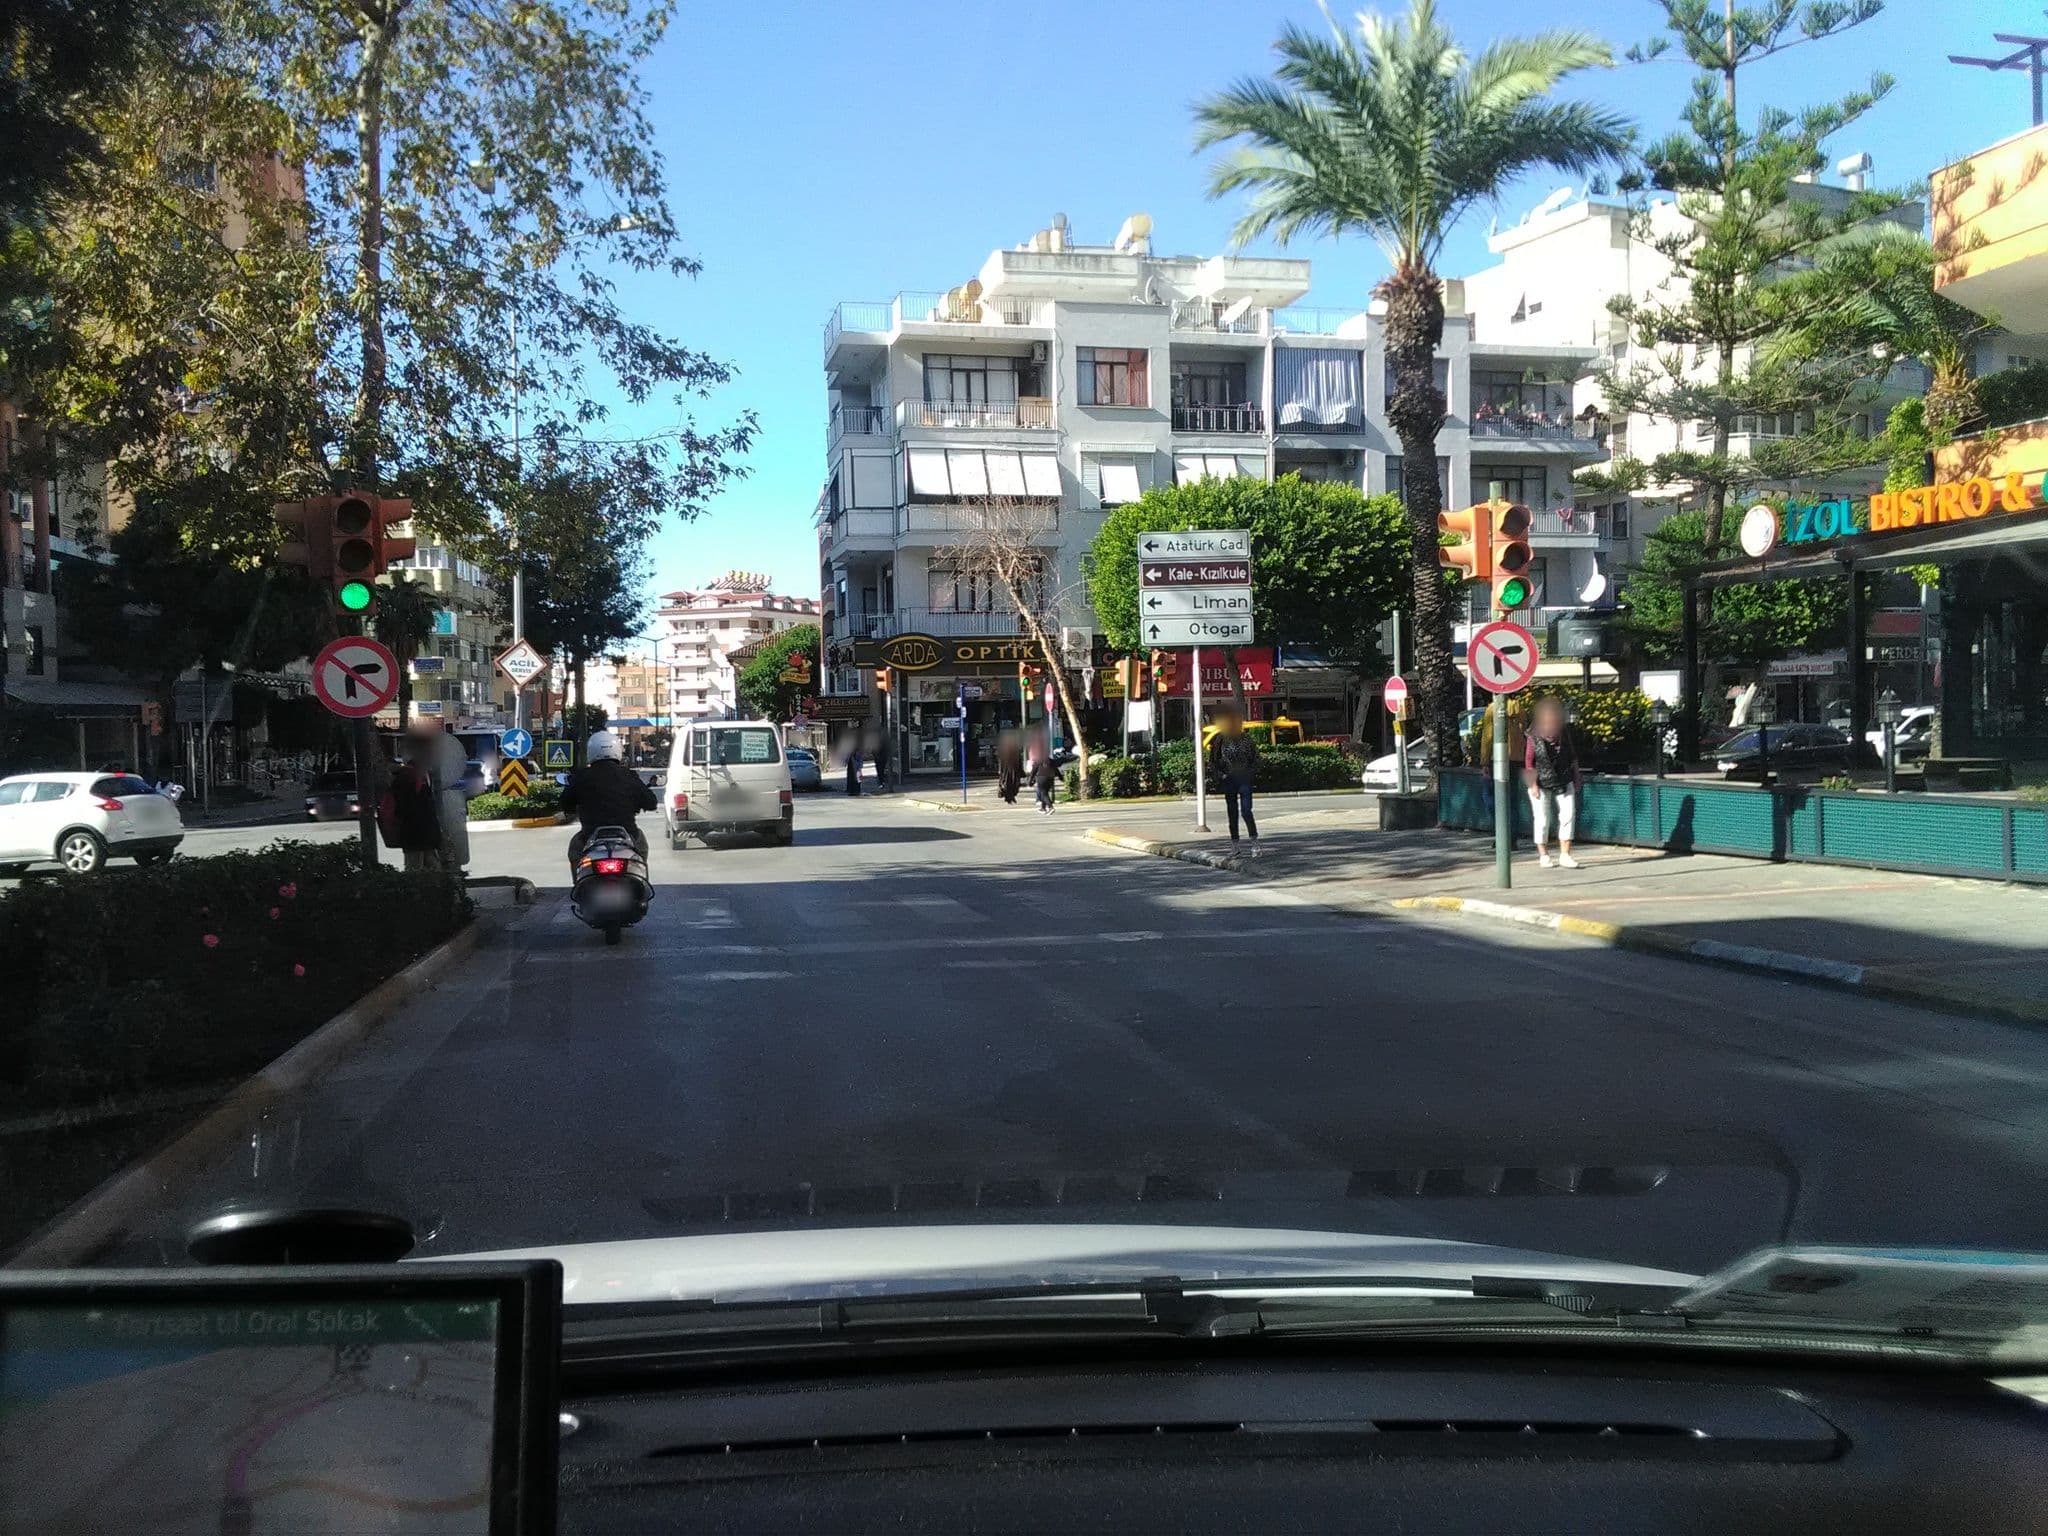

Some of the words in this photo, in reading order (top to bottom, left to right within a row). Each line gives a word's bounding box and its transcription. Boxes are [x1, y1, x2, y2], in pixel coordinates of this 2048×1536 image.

[1870, 477, 1995, 532] BISTRO
[2001, 471, 2034, 512] &
[1166, 539, 1215, 552] Atatürk
[1193, 595, 1248, 609] Liman
[1189, 622, 1248, 638] Otogar
[890, 643, 938, 664] ARDA
[306, 1308, 379, 1333] Sokak
